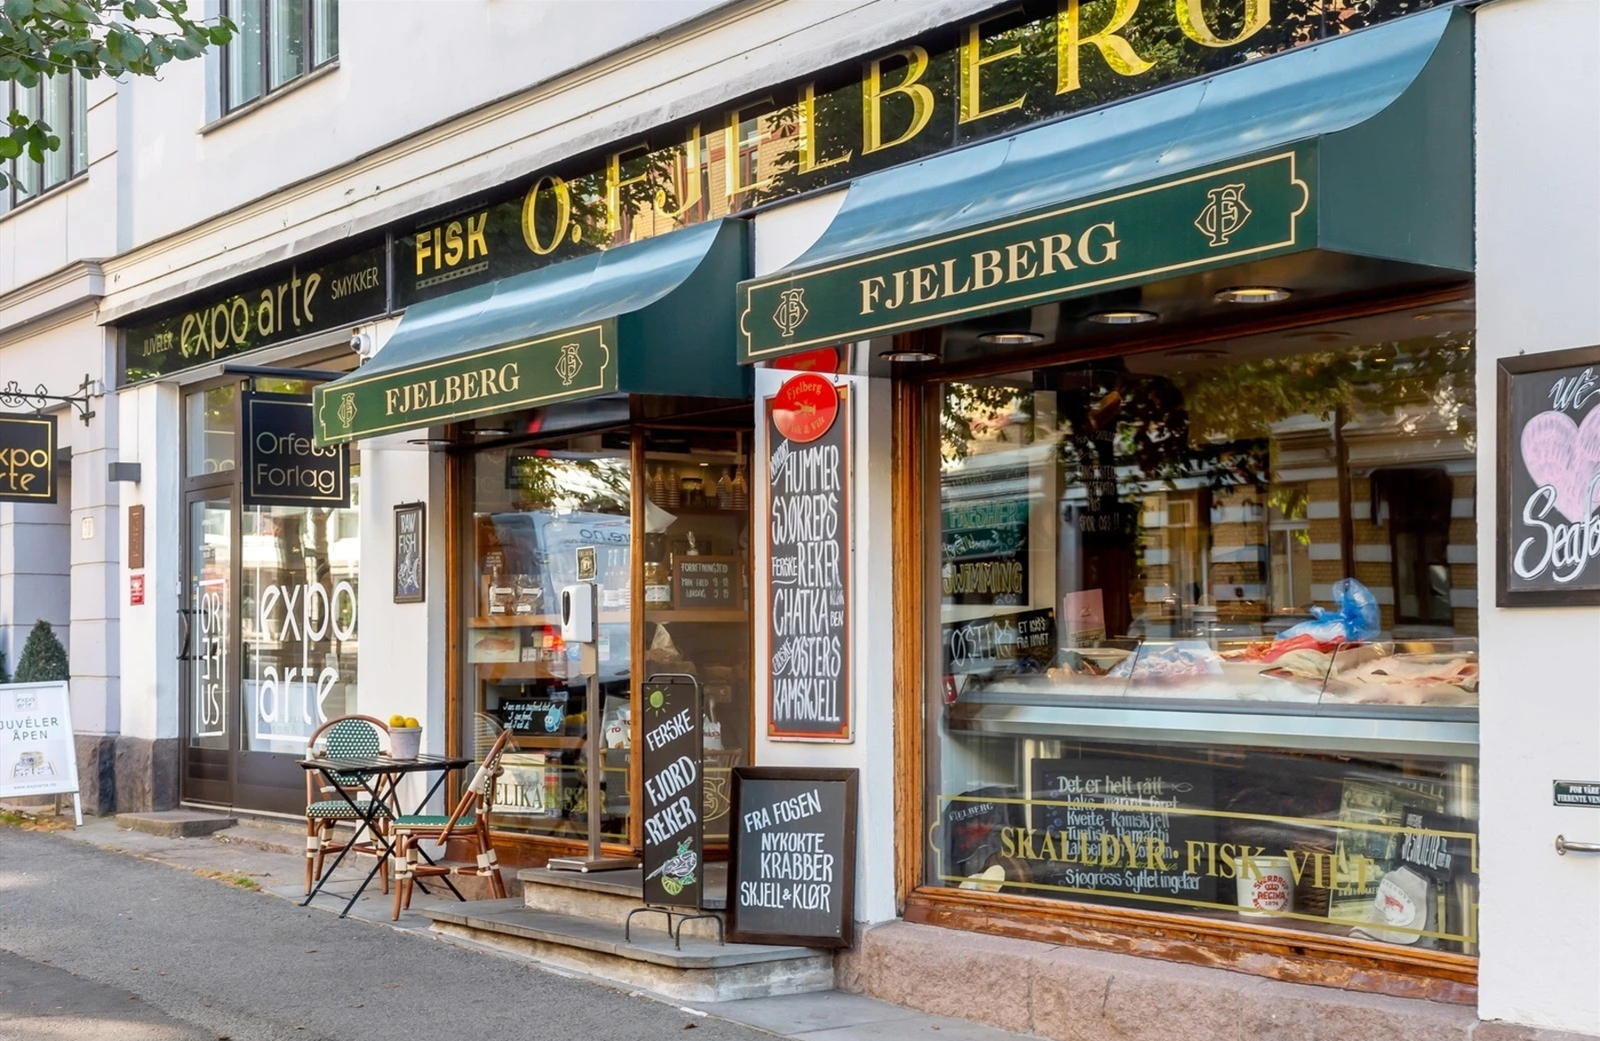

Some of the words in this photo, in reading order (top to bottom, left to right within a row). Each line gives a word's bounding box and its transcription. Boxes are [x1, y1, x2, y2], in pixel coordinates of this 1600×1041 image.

[416, 211, 489, 276] FISK
[858, 220, 1122, 315] FJELBERG
[180, 295, 249, 359] expo
[257, 267, 322, 337] arte
[331, 266, 379, 301] SMYKKER
[385, 362, 520, 416] FJELBERG
[786, 380, 823, 401] Fjelberg
[257, 463, 335, 494] Forlag
[785, 444, 841, 494] HUMMER
[400, 513, 416, 534] RAW
[771, 491, 839, 546] SJØKREPS
[398, 532, 417, 554] FISH
[771, 555, 798, 577] FERSKE
[797, 539, 843, 588] REKER
[260, 580, 357, 668] expo
[773, 588, 830, 637] CHATKA
[830, 610, 844, 627] BEN
[788, 636, 841, 678] ØSTERS
[950, 619, 1014, 667] ØSTERS
[259, 666, 340, 725] arte
[773, 678, 841, 722] KAMSKJELL
[13, 730, 48, 741] ÅPEN
[645, 707, 694, 752] FERSKE
[1057, 775, 1084, 794] Det
[1084, 778, 1102, 793] er
[1105, 775, 1133, 794] helt
[743, 807, 771, 833] FRA
[772, 788, 822, 825] FOSEN
[1067, 810, 1104, 827] Kveite
[1111, 812, 1170, 833] Kamskjell
[761, 832, 825, 854] NYKOKTE
[1000, 826, 1168, 873] SKALLDYR
[1185, 840, 1266, 882] FISK
[1283, 849, 1374, 894] VILT
[760, 853, 833, 883] KRABBER
[1257, 891, 1286, 900] REGINA
